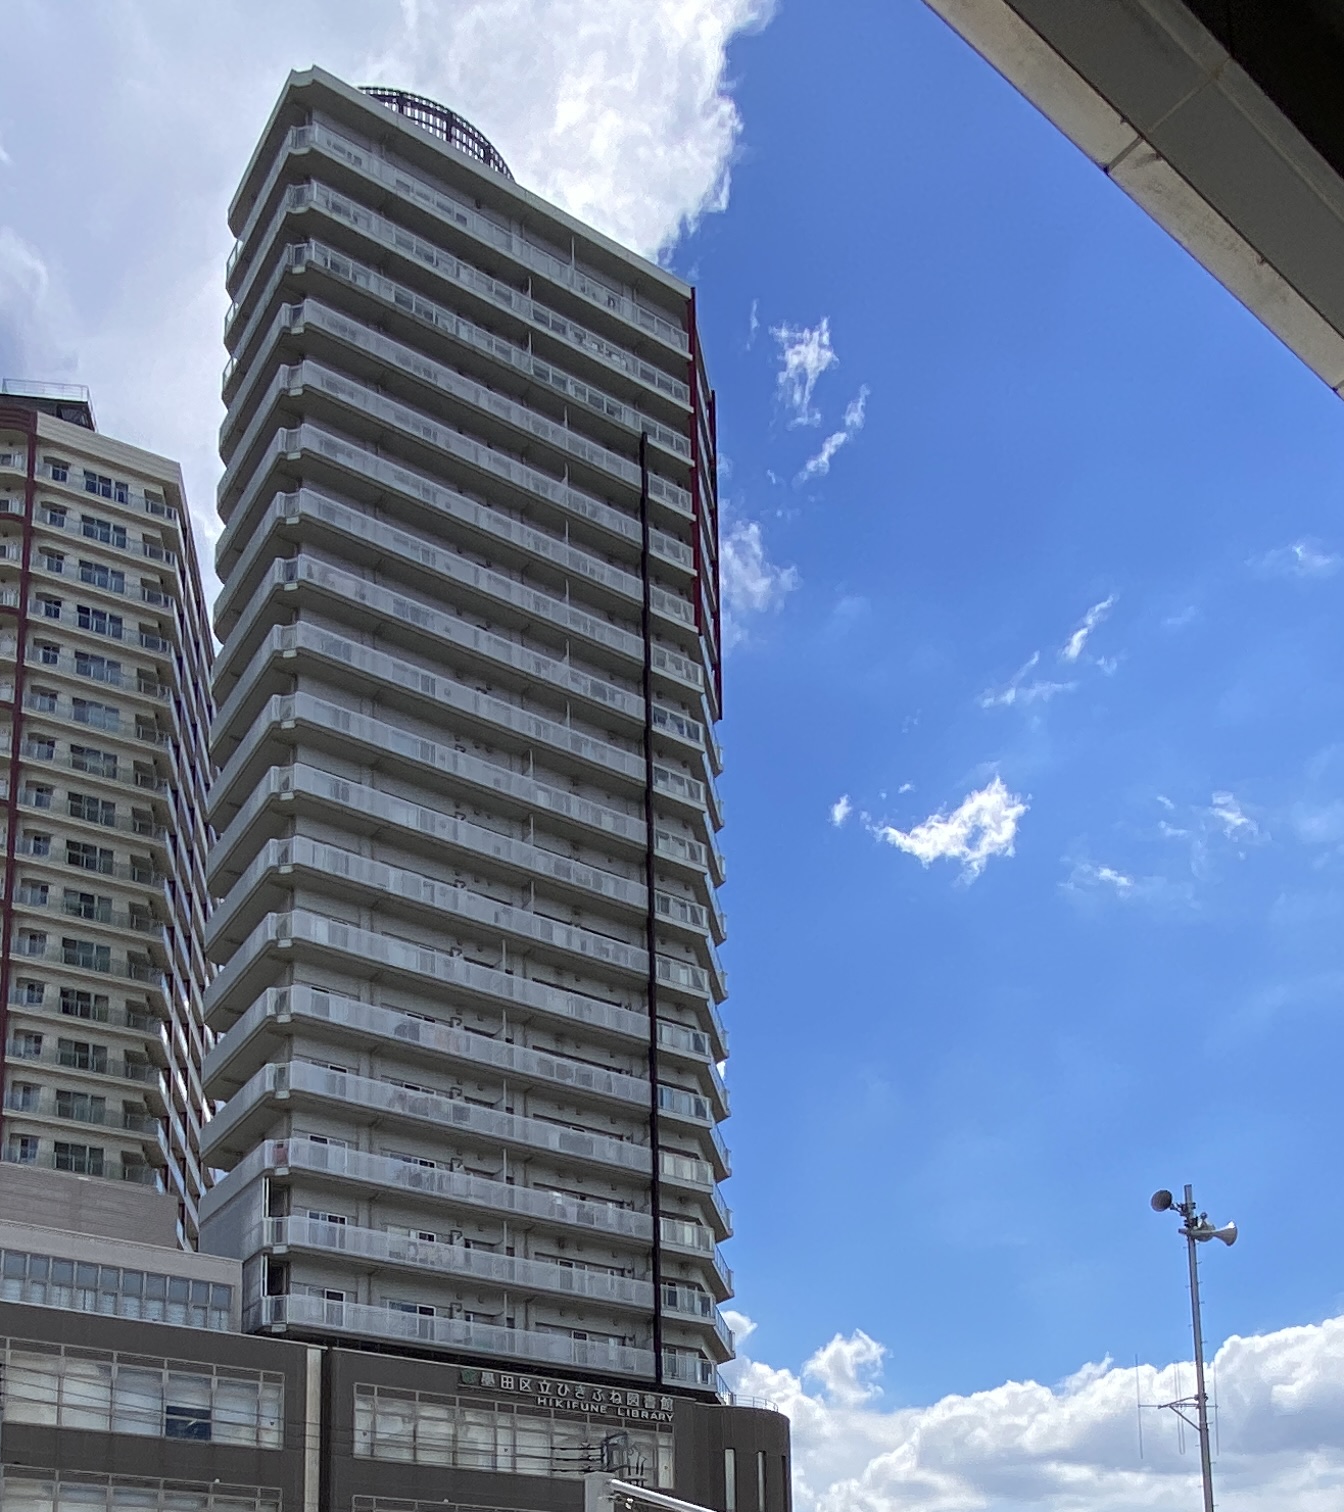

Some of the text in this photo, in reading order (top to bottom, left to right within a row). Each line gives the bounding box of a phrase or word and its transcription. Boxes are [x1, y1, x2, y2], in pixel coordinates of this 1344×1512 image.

[480, 1371, 674, 1412] 墨田区立ひきふね図書館
[537, 1396, 675, 1422] HIKIFUNE LIBRARY
